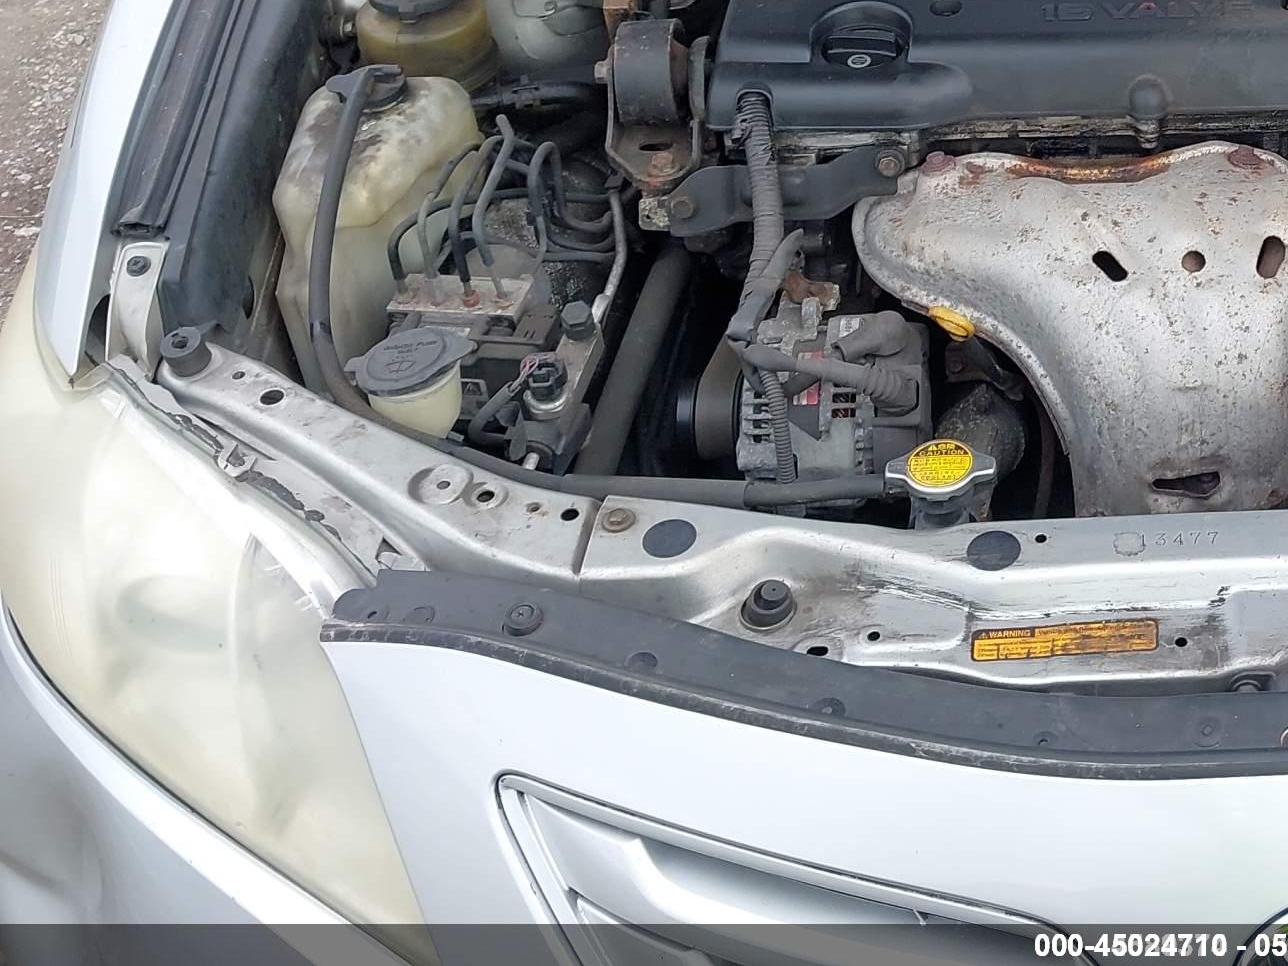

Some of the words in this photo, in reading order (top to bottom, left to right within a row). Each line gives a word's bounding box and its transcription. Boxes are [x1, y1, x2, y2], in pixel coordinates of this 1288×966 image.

[1041, 2, 1096, 22] 16
[1099, 0, 1257, 21] VALVE
[918, 448, 965, 457] CAUTION
[989, 629, 1031, 639] WARNING
